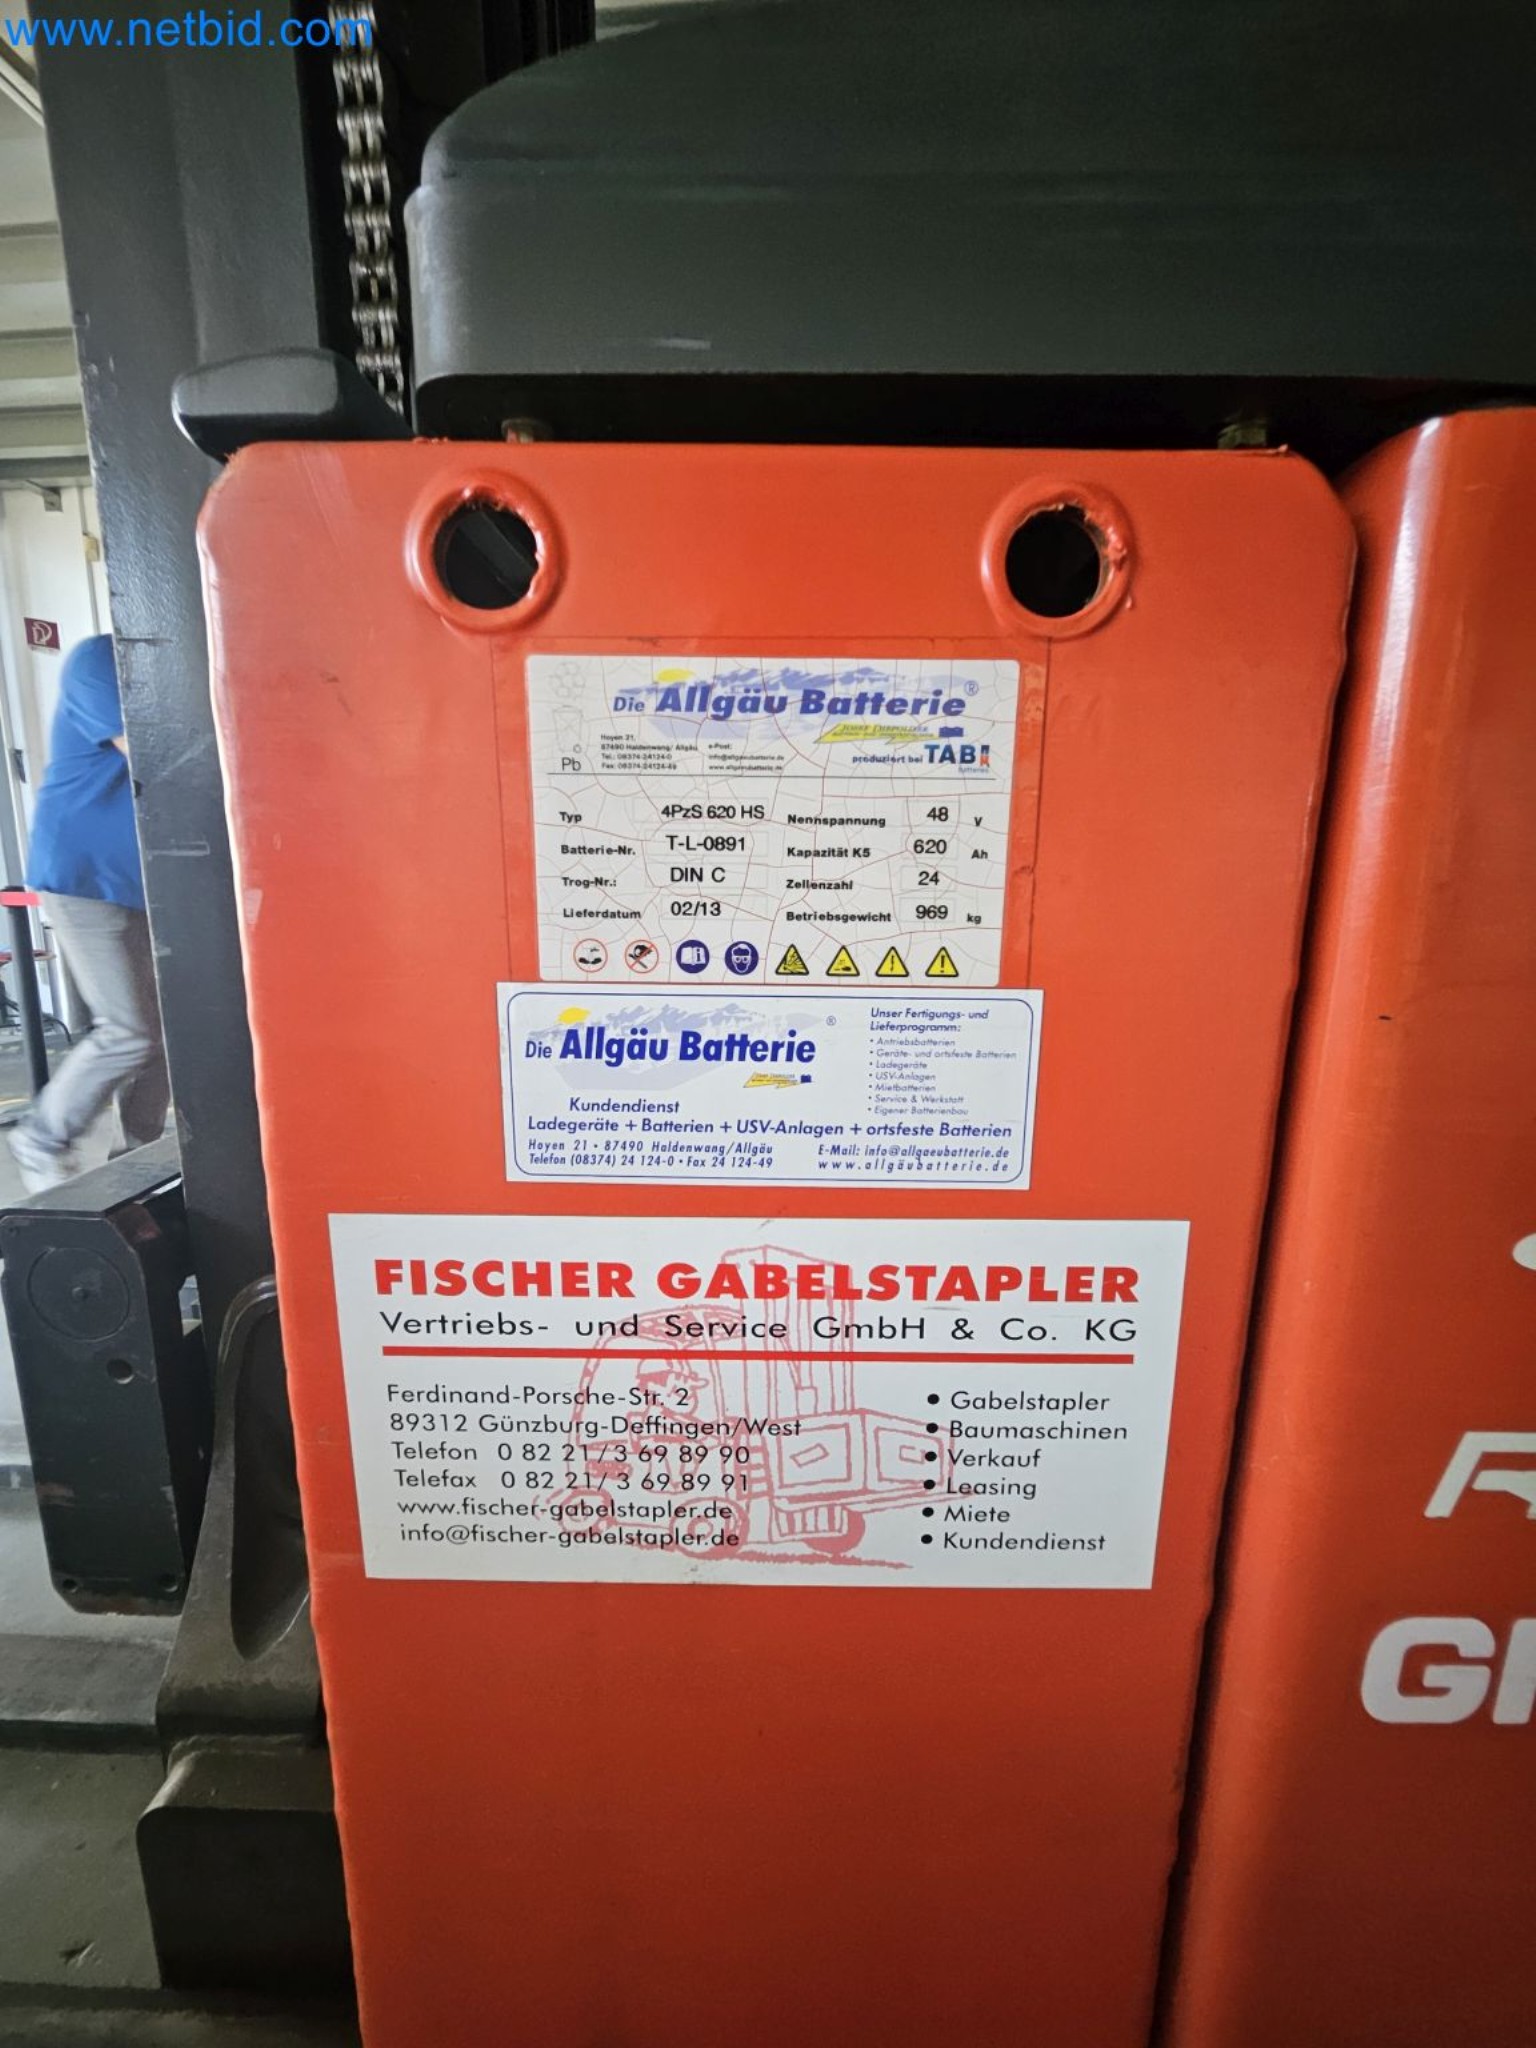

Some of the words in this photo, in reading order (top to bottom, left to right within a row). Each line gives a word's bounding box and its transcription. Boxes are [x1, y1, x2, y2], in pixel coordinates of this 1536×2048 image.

[613, 696, 645, 712] Die
[655, 685, 788, 721] Allgäu
[800, 688, 966, 716] Batterie
[852, 754, 905, 765] produziert
[908, 755, 923, 764] bei
[924, 744, 977, 765] TAB
[561, 757, 582, 772] Pb
[560, 811, 582, 823] Typ
[661, 805, 702, 819] 4PzS
[707, 805, 736, 819] 620
[741, 805, 765, 819] HS
[787, 814, 886, 828] Nennspannung
[926, 807, 949, 822] 48
[974, 816, 983, 827] V
[561, 844, 636, 856] Batterie-Nr.
[665, 836, 745, 851] T-L-0891
[787, 847, 848, 860] Kapazität
[853, 848, 870, 858] K5
[913, 839, 947, 854] 620
[971, 850, 988, 860] Ah
[562, 877, 617, 888] Trog-Nr.:
[670, 867, 703, 882] DIN
[711, 867, 726, 882] C
[786, 880, 853, 890] Zellenzahl
[918, 871, 940, 886] 24
[563, 908, 642, 919] Lieferdatum
[670, 901, 722, 917] 02/13
[786, 912, 891, 924] Betriebsgewicht
[915, 905, 948, 920] 969
[967, 913, 982, 924] kg
[871, 1008, 904, 1018] Unser
[905, 1008, 965, 1020] Fertigungs-
[968, 1009, 990, 1019] und
[870, 1021, 962, 1034] Lieferprogramm:
[525, 1041, 552, 1058] Die
[559, 1026, 669, 1068] Allgäu
[678, 1029, 816, 1063] Batterie
[876, 1036, 956, 1046] Antriebsbatterien
[876, 1048, 912, 1058] Geräte-
[915, 1050, 932, 1058] und
[934, 1049, 973, 1058] ortsfeste
[976, 1050, 1017, 1058] Batterien
[876, 1061, 928, 1070] Ladegeräte
[875, 1072, 936, 1082] USV-Anlagen
[874, 1084, 936, 1092] Mietbatterien
[569, 1097, 680, 1114] Kundendienst
[874, 1094, 908, 1104] Service
[911, 1096, 918, 1104] &
[921, 1095, 964, 1104] Werkstatt
[874, 1106, 908, 1116] Eigener
[911, 1106, 969, 1116] Batterienbau
[528, 1116, 619, 1134] Ladegeräte
[625, 1121, 638, 1132] +
[641, 1118, 714, 1133] Batterien
[719, 1122, 732, 1134] +
[736, 1120, 844, 1138] USV-Anlagen
[850, 1124, 862, 1135] +
[866, 1122, 934, 1137] ortsfeste
[939, 1123, 1012, 1138] Batterien
[528, 1140, 565, 1153] Hoyen
[574, 1140, 588, 1150] 21
[604, 1141, 644, 1152] 87490
[651, 1142, 773, 1156] Haldenwang/Allgäu
[818, 1144, 861, 1156] E-Mail:
[529, 1153, 566, 1165] Telefon
[570, 1154, 617, 1168] (08374)
[622, 1156, 635, 1166] 24
[640, 1156, 674, 1167] 124-0
[686, 1156, 706, 1168] Fax
[711, 1156, 726, 1168] 24
[731, 1157, 773, 1169] 124-49
[374, 1259, 635, 1299] FISCHER
[656, 1262, 1140, 1303] GABELSTAPLER
[380, 1311, 549, 1336] Vertriebs-
[576, 1314, 639, 1338] und
[664, 1314, 788, 1338] Service
[812, 1316, 926, 1340] GmbH
[950, 1318, 975, 1341] &
[1000, 1318, 1057, 1342] Co.
[1086, 1318, 1137, 1342] KG
[387, 1384, 665, 1407] Ferdinand-Porsche-Str.
[675, 1387, 690, 1406] 2
[950, 1390, 1110, 1414] Gabelstapler
[390, 1412, 468, 1432] 89312
[478, 1414, 803, 1440] Günzburg-Deffingen/West
[950, 1420, 1128, 1440] Baumaschinen
[391, 1440, 478, 1461] Telefon
[497, 1443, 512, 1461] 0
[522, 1443, 551, 1461] 82
[638, 1445, 668, 1463] 69
[679, 1446, 709, 1464] 89
[719, 1446, 750, 1464] 90
[947, 1448, 1042, 1468] Verkauf
[393, 1468, 478, 1488] Telefax
[500, 1471, 516, 1489] 0
[526, 1471, 554, 1490] 82
[641, 1473, 670, 1491] 69
[682, 1474, 710, 1492] 89
[722, 1474, 749, 1492] 91
[946, 1476, 1037, 1500] Leasing
[397, 1496, 734, 1522] www.fischer-gabelstapler.de
[944, 1505, 1011, 1523] Miete
[400, 1522, 740, 1550] info@fischer-gabelstapler.de
[944, 1532, 1107, 1551] Kundendienst
